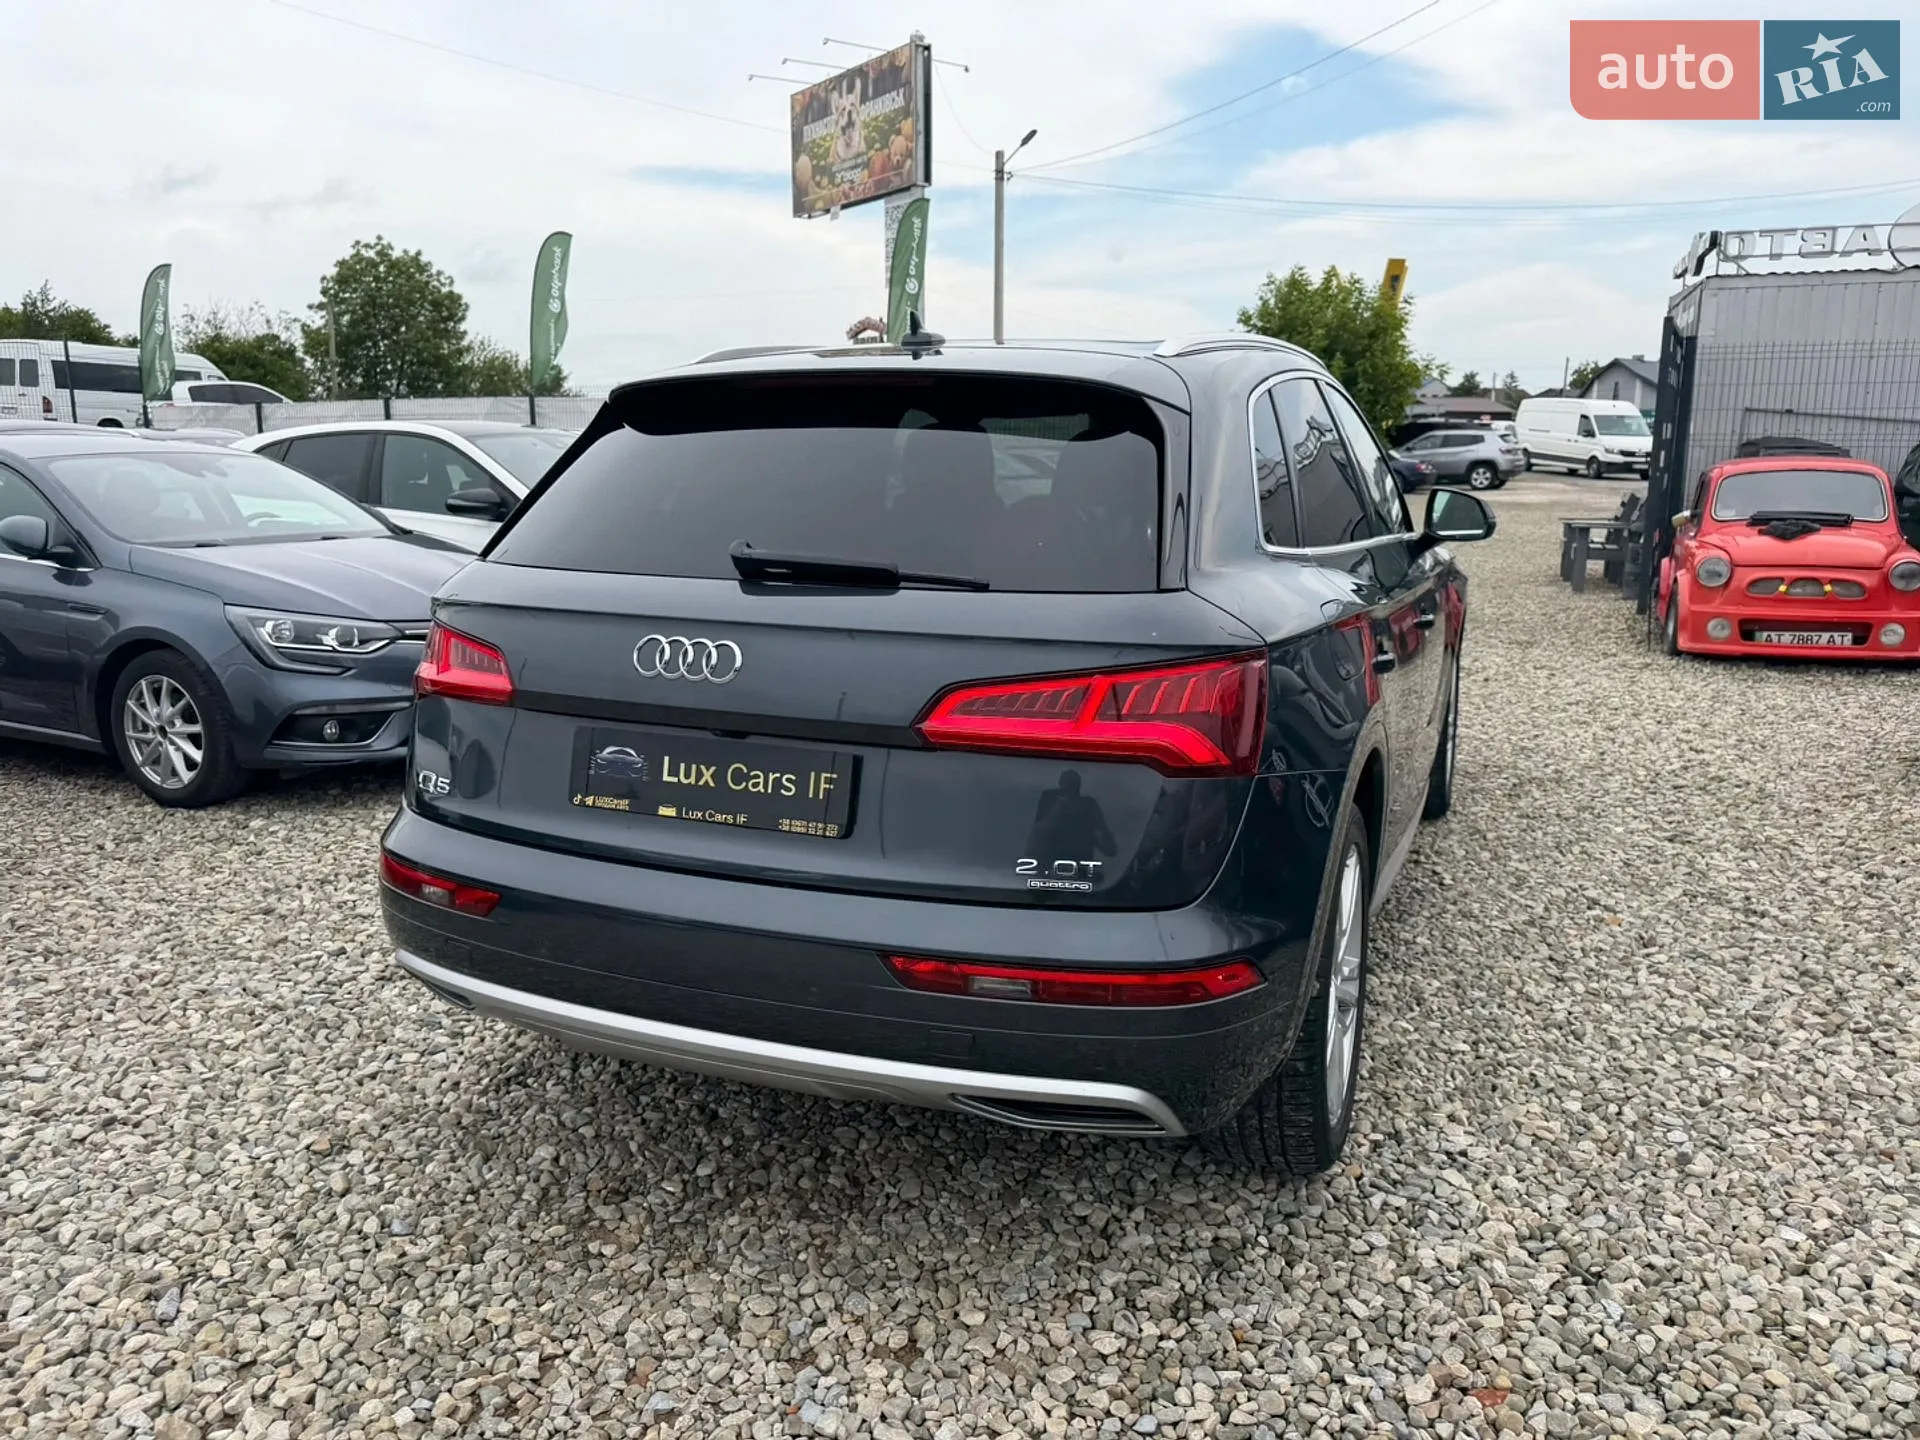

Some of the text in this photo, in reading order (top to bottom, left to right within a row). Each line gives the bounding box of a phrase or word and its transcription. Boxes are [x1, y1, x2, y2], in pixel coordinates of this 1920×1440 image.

[1764, 633, 1848, 645] AT 7887 AT
[419, 770, 450, 794] Q5
[662, 755, 838, 799] Lux Cars IF
[682, 807, 748, 824] Lux Cars IF
[1015, 858, 1102, 878] 2.0T
[1029, 880, 1090, 890] quattro
